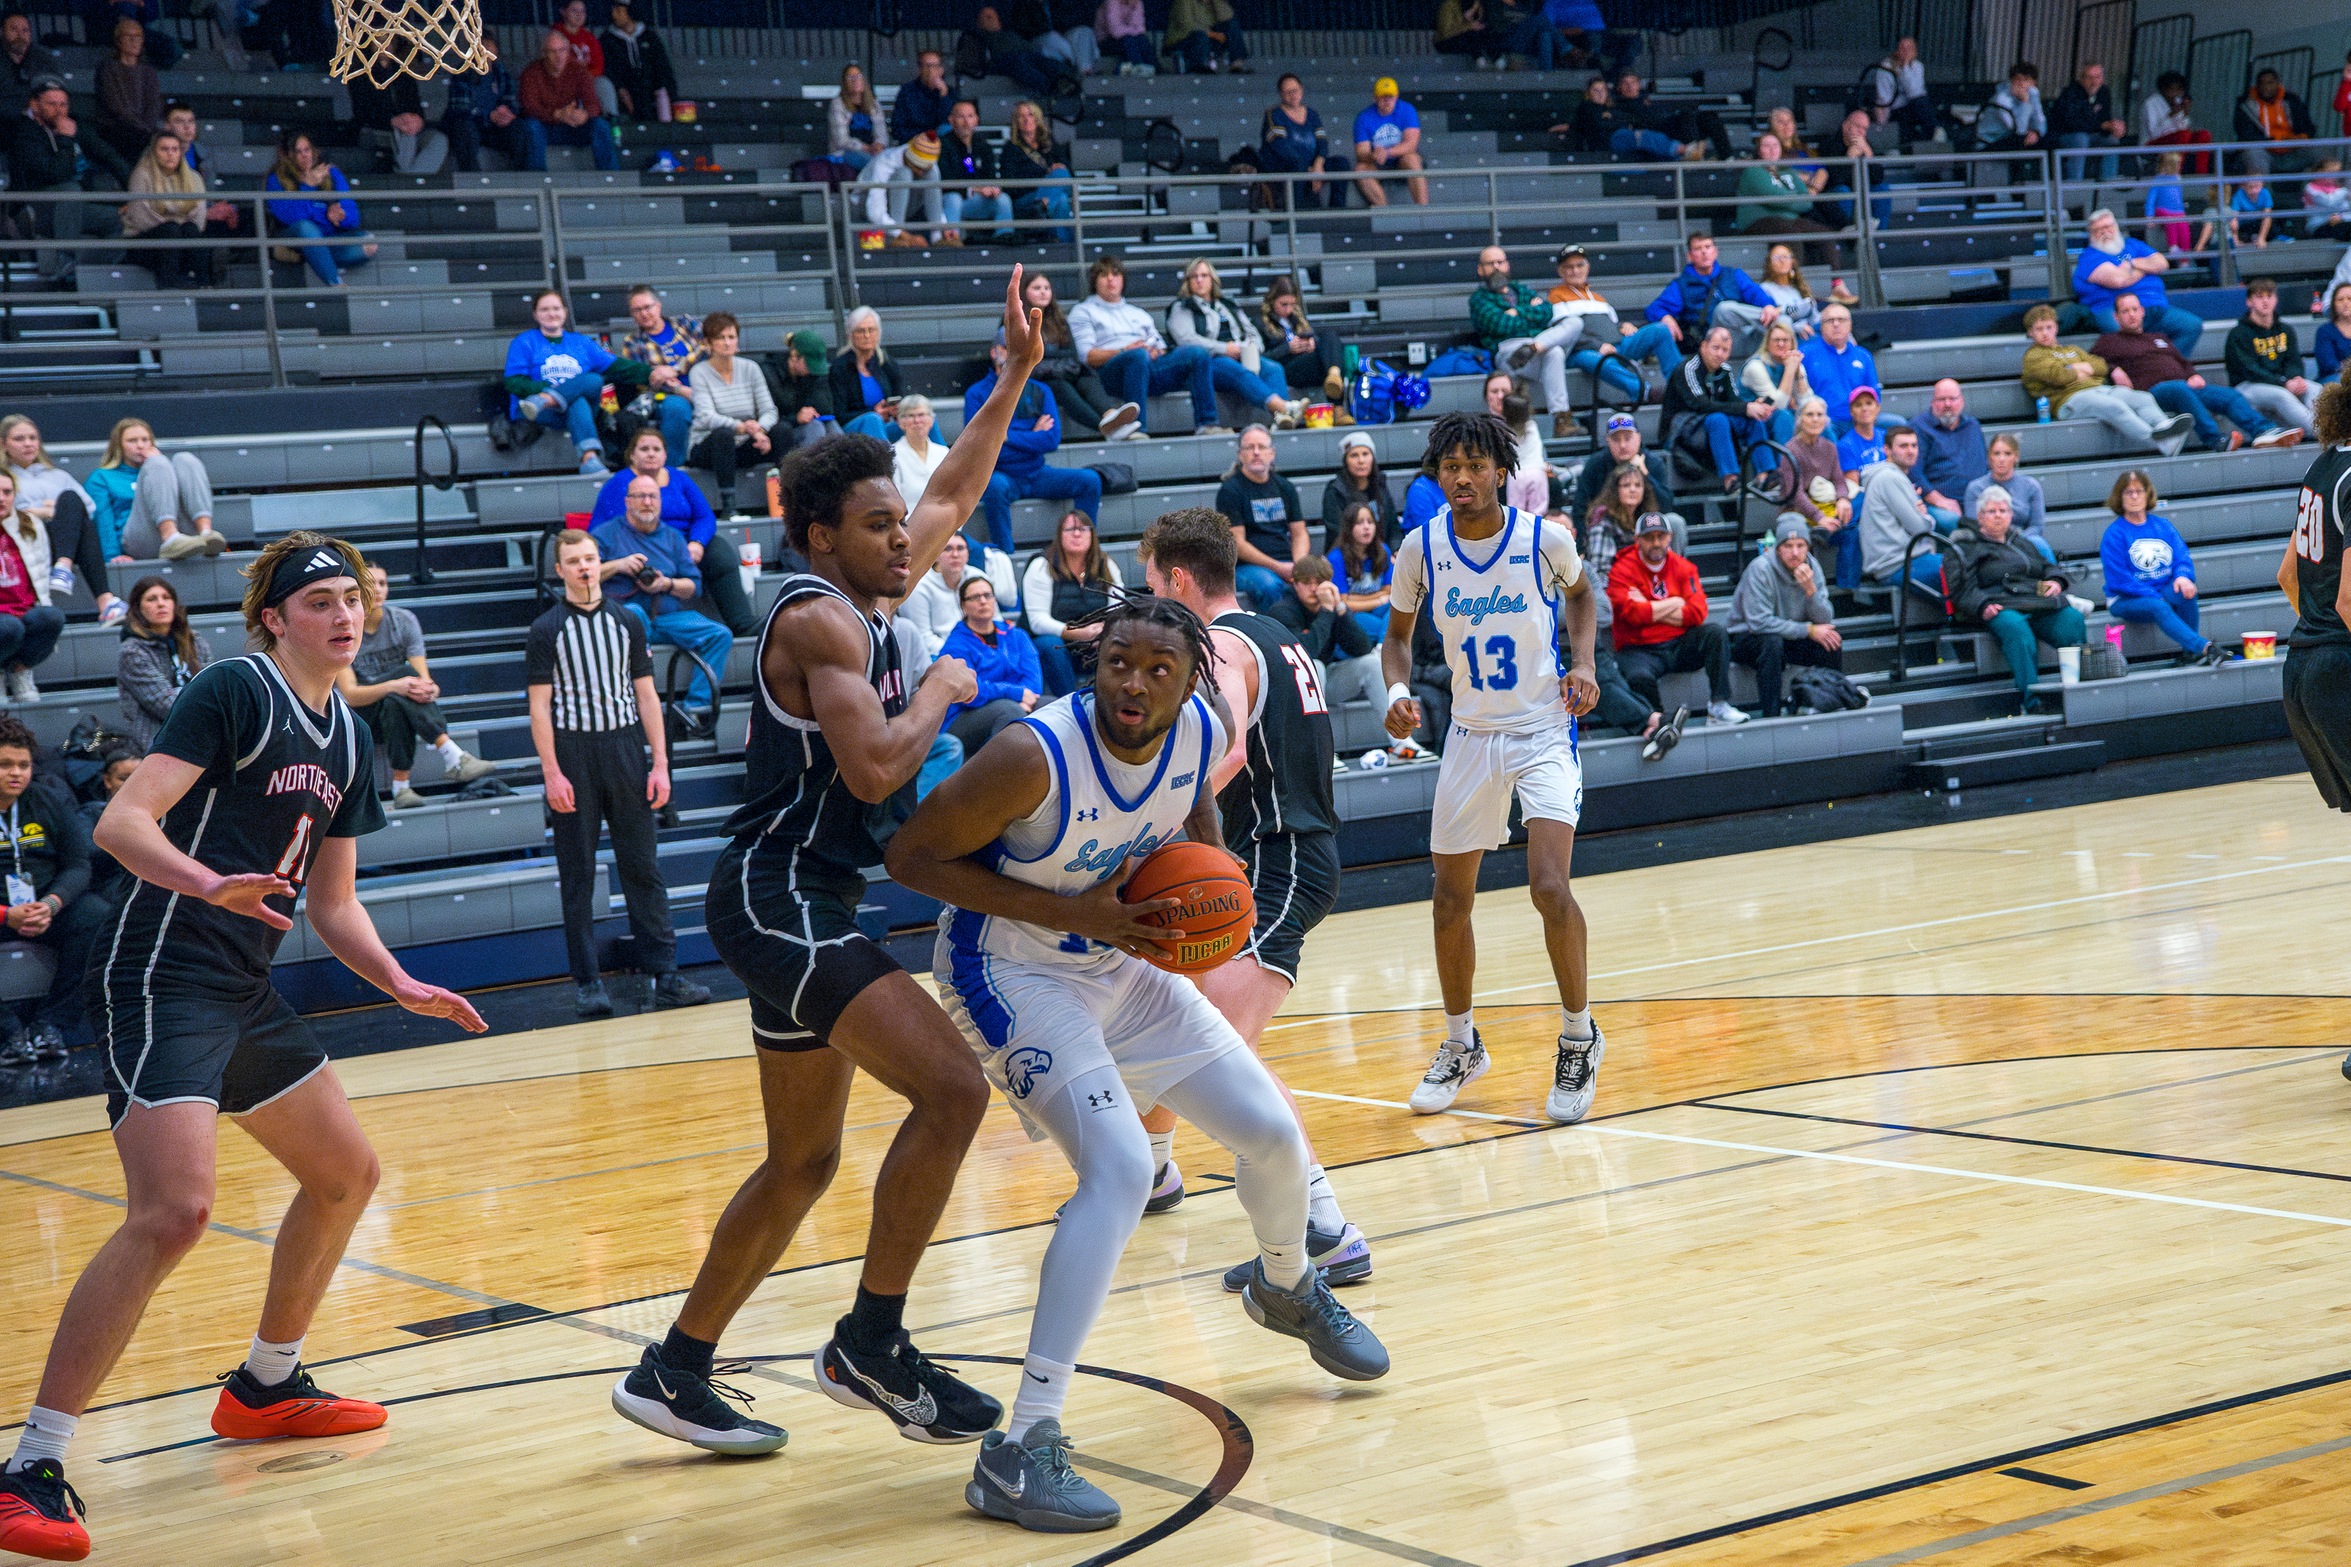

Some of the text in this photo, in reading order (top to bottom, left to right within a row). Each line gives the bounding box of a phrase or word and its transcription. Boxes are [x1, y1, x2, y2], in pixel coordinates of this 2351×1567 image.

[2295, 485, 2325, 565] 20
[1445, 585, 1528, 626] Eagles
[1279, 642, 1329, 716] 21
[1461, 634, 1518, 692] 13
